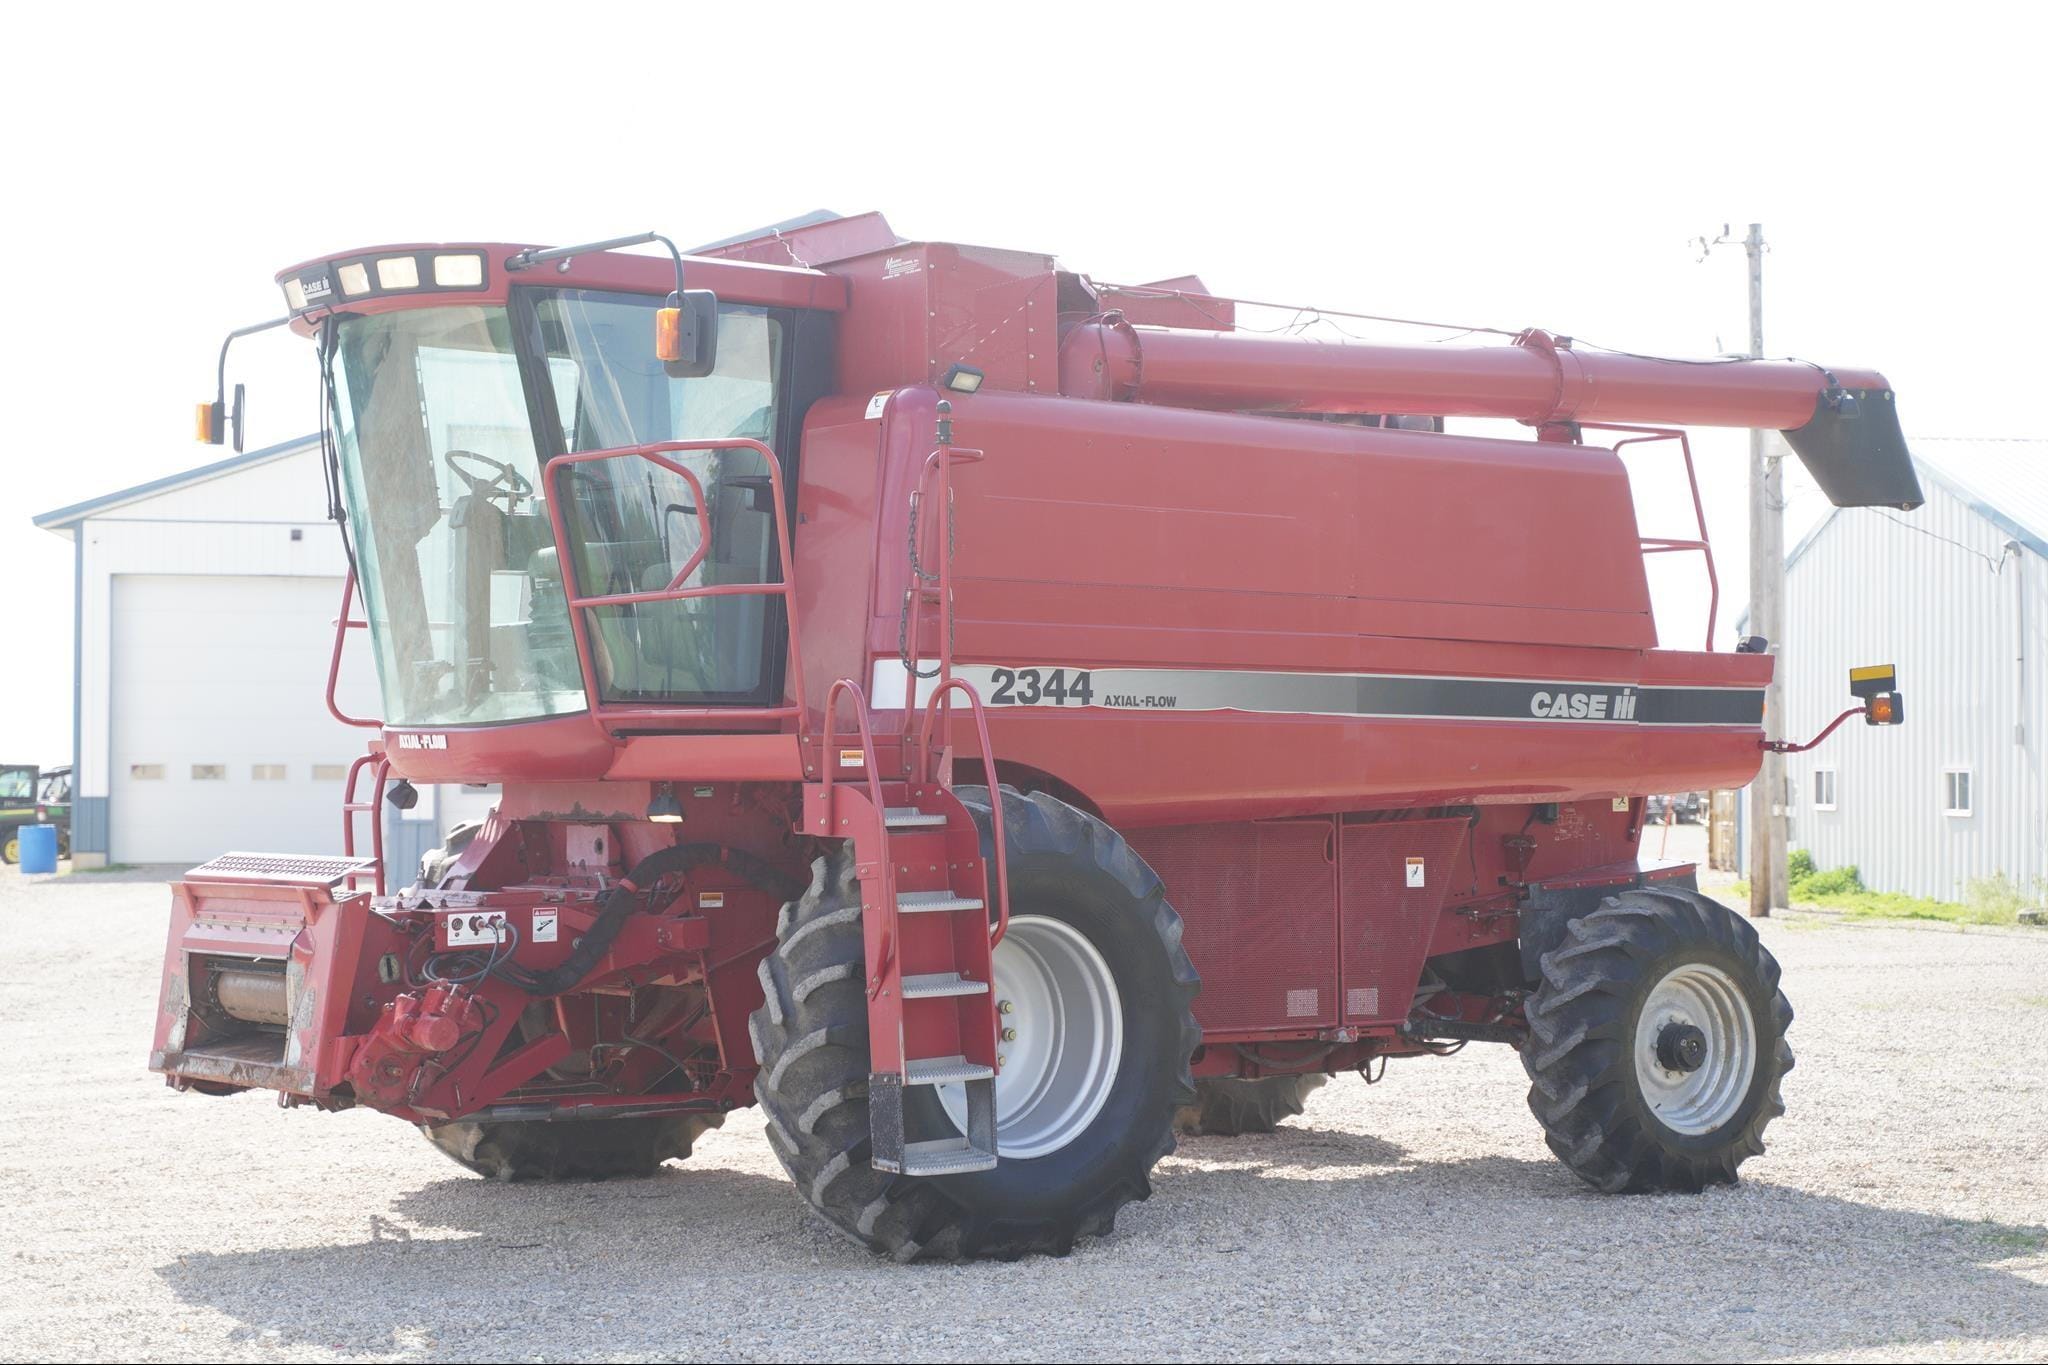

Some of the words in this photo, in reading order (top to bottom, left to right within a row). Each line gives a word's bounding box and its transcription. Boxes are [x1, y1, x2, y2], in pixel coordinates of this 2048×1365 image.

[303, 281, 322, 295] CASE
[990, 668, 1094, 706] 2344
[1103, 695, 1177, 708] AXIAL-FLOW
[1530, 691, 1608, 719] CASE
